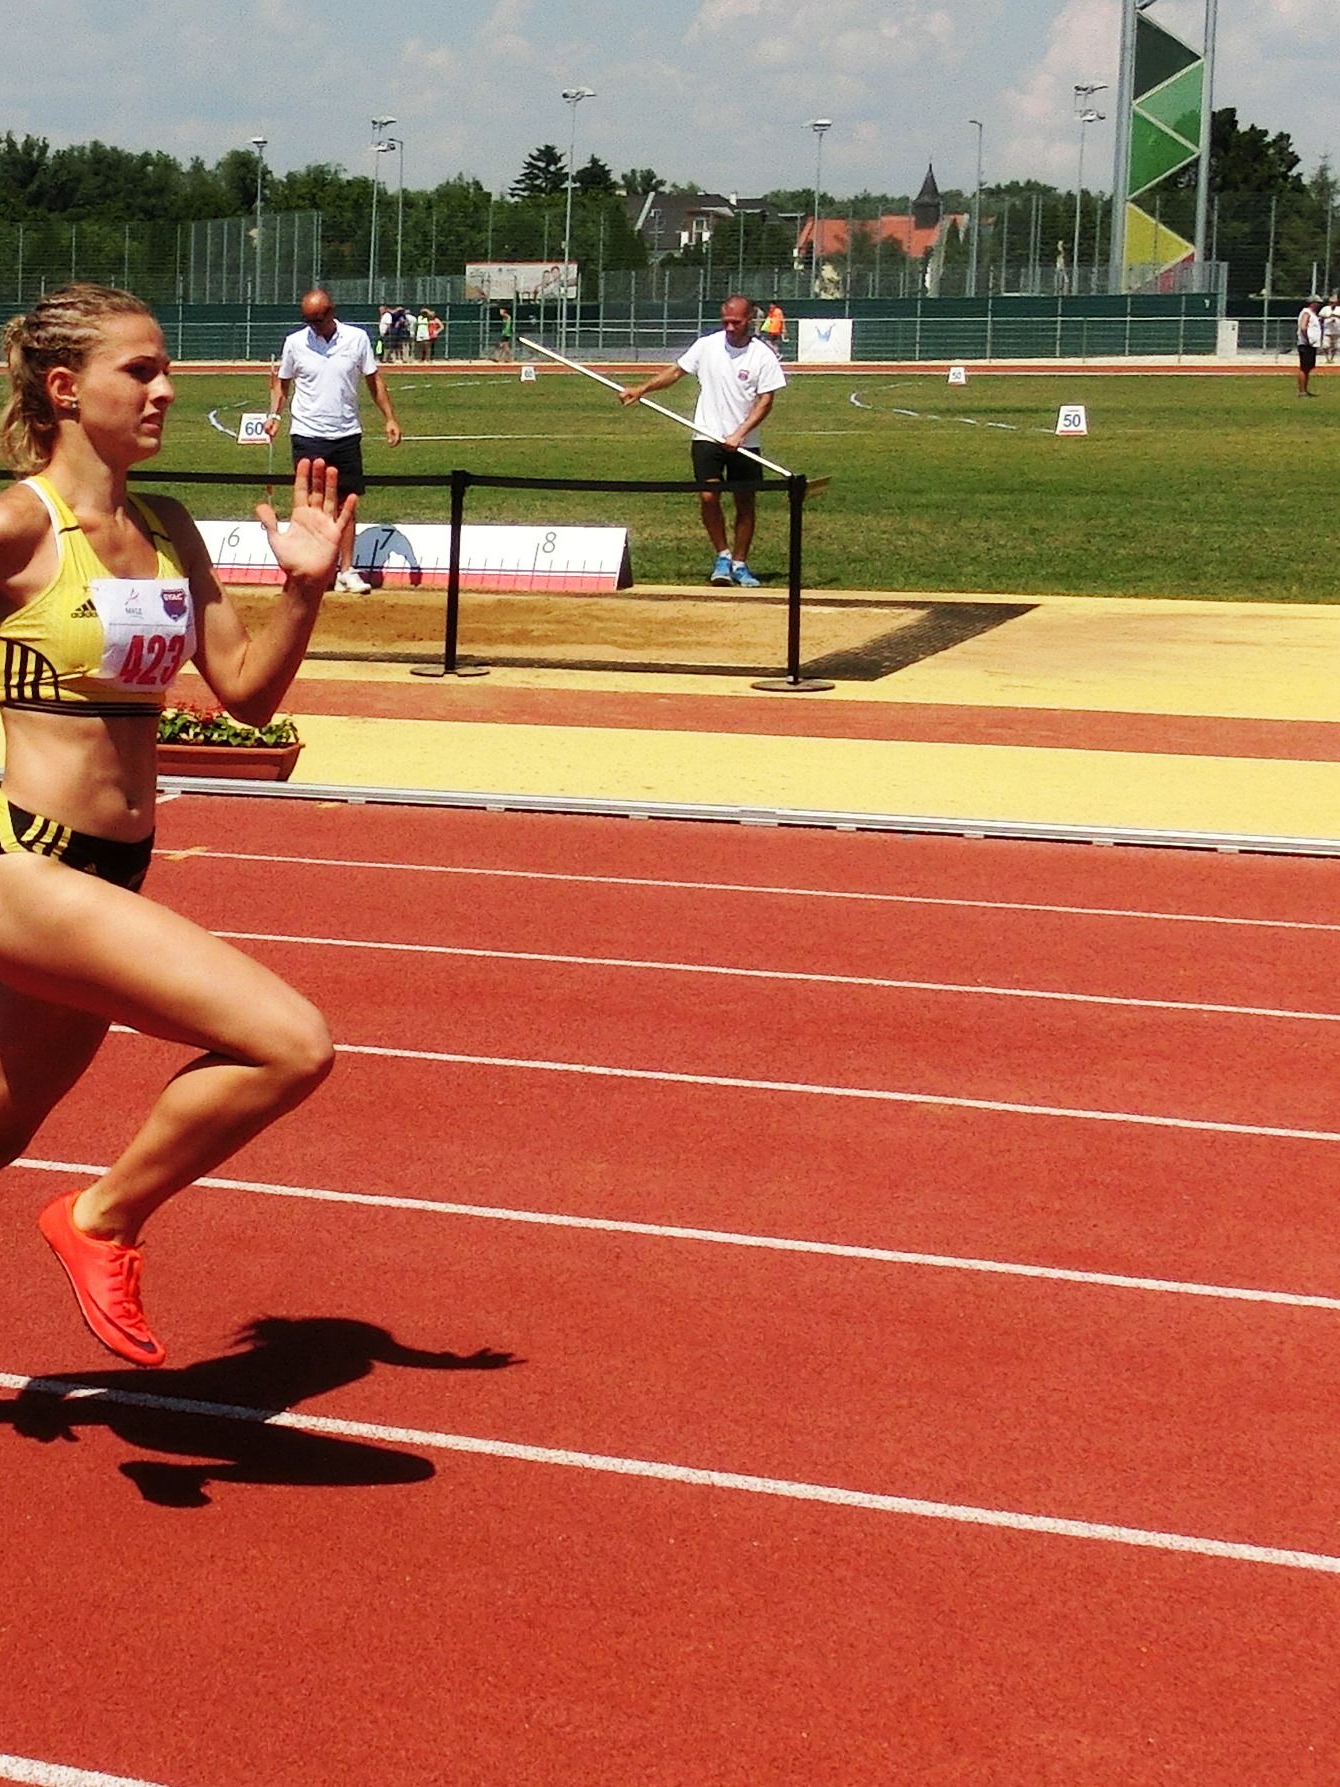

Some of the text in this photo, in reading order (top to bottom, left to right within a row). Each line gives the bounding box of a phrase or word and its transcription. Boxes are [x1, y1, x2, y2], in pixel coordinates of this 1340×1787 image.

[245, 421, 265, 436] 60
[1063, 413, 1082, 428] 50
[227, 527, 241, 548] 6
[380, 528, 396, 551] 7
[542, 531, 557, 554] 8
[120, 634, 185, 685] 423
